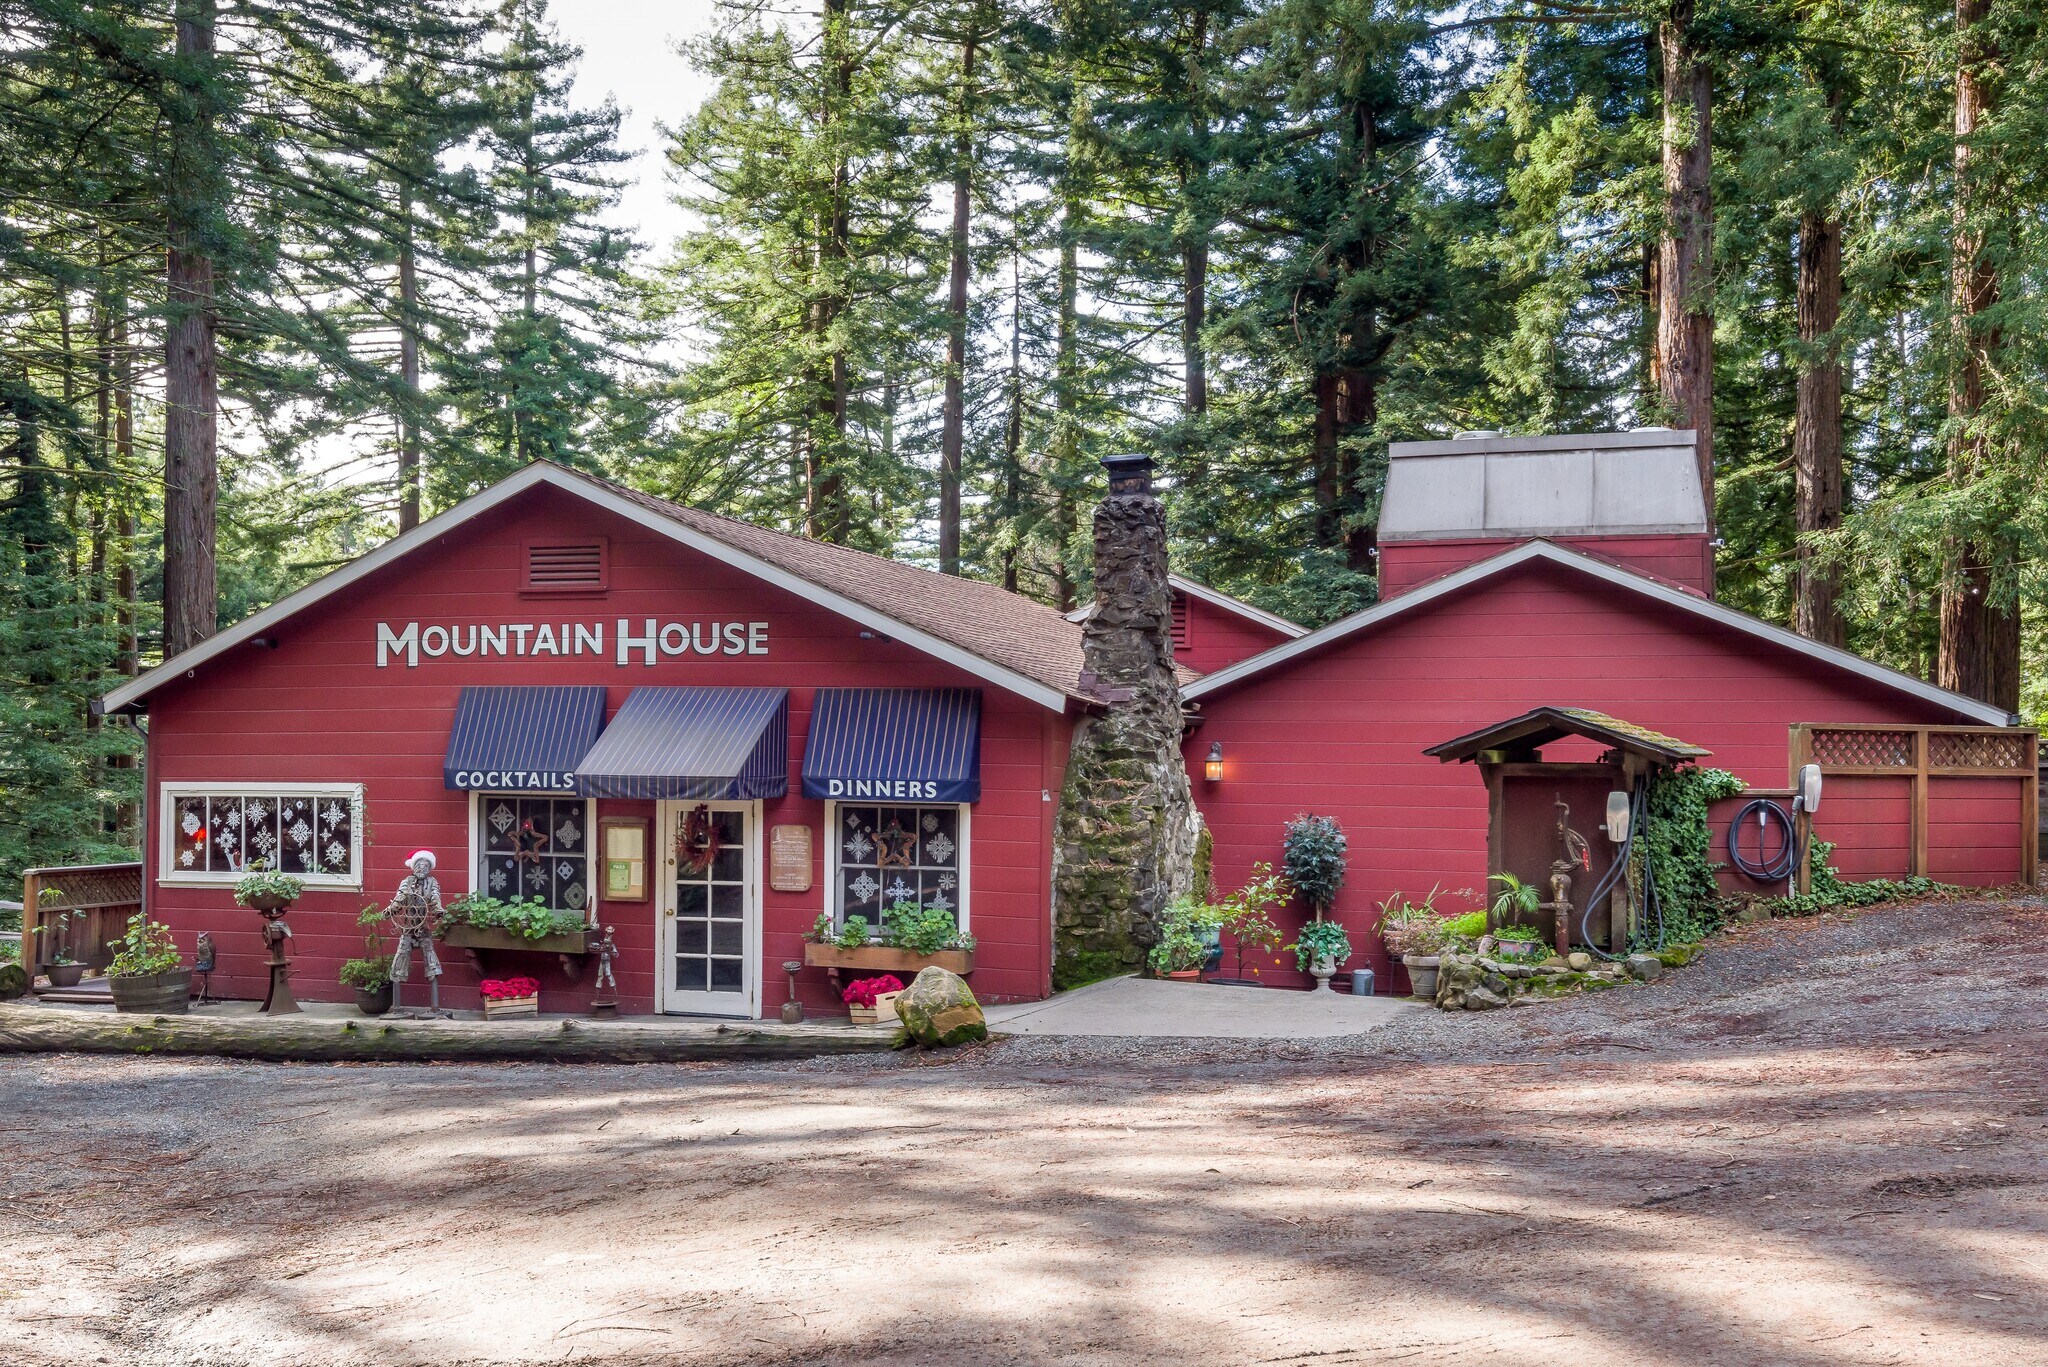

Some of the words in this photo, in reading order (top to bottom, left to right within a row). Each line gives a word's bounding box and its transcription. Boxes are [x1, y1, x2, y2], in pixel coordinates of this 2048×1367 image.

[376, 622, 604, 667] MOUNTAIN
[616, 618, 769, 666] HOUSE
[455, 771, 575, 788] COCKTAILS
[829, 779, 938, 799] DINNERS
